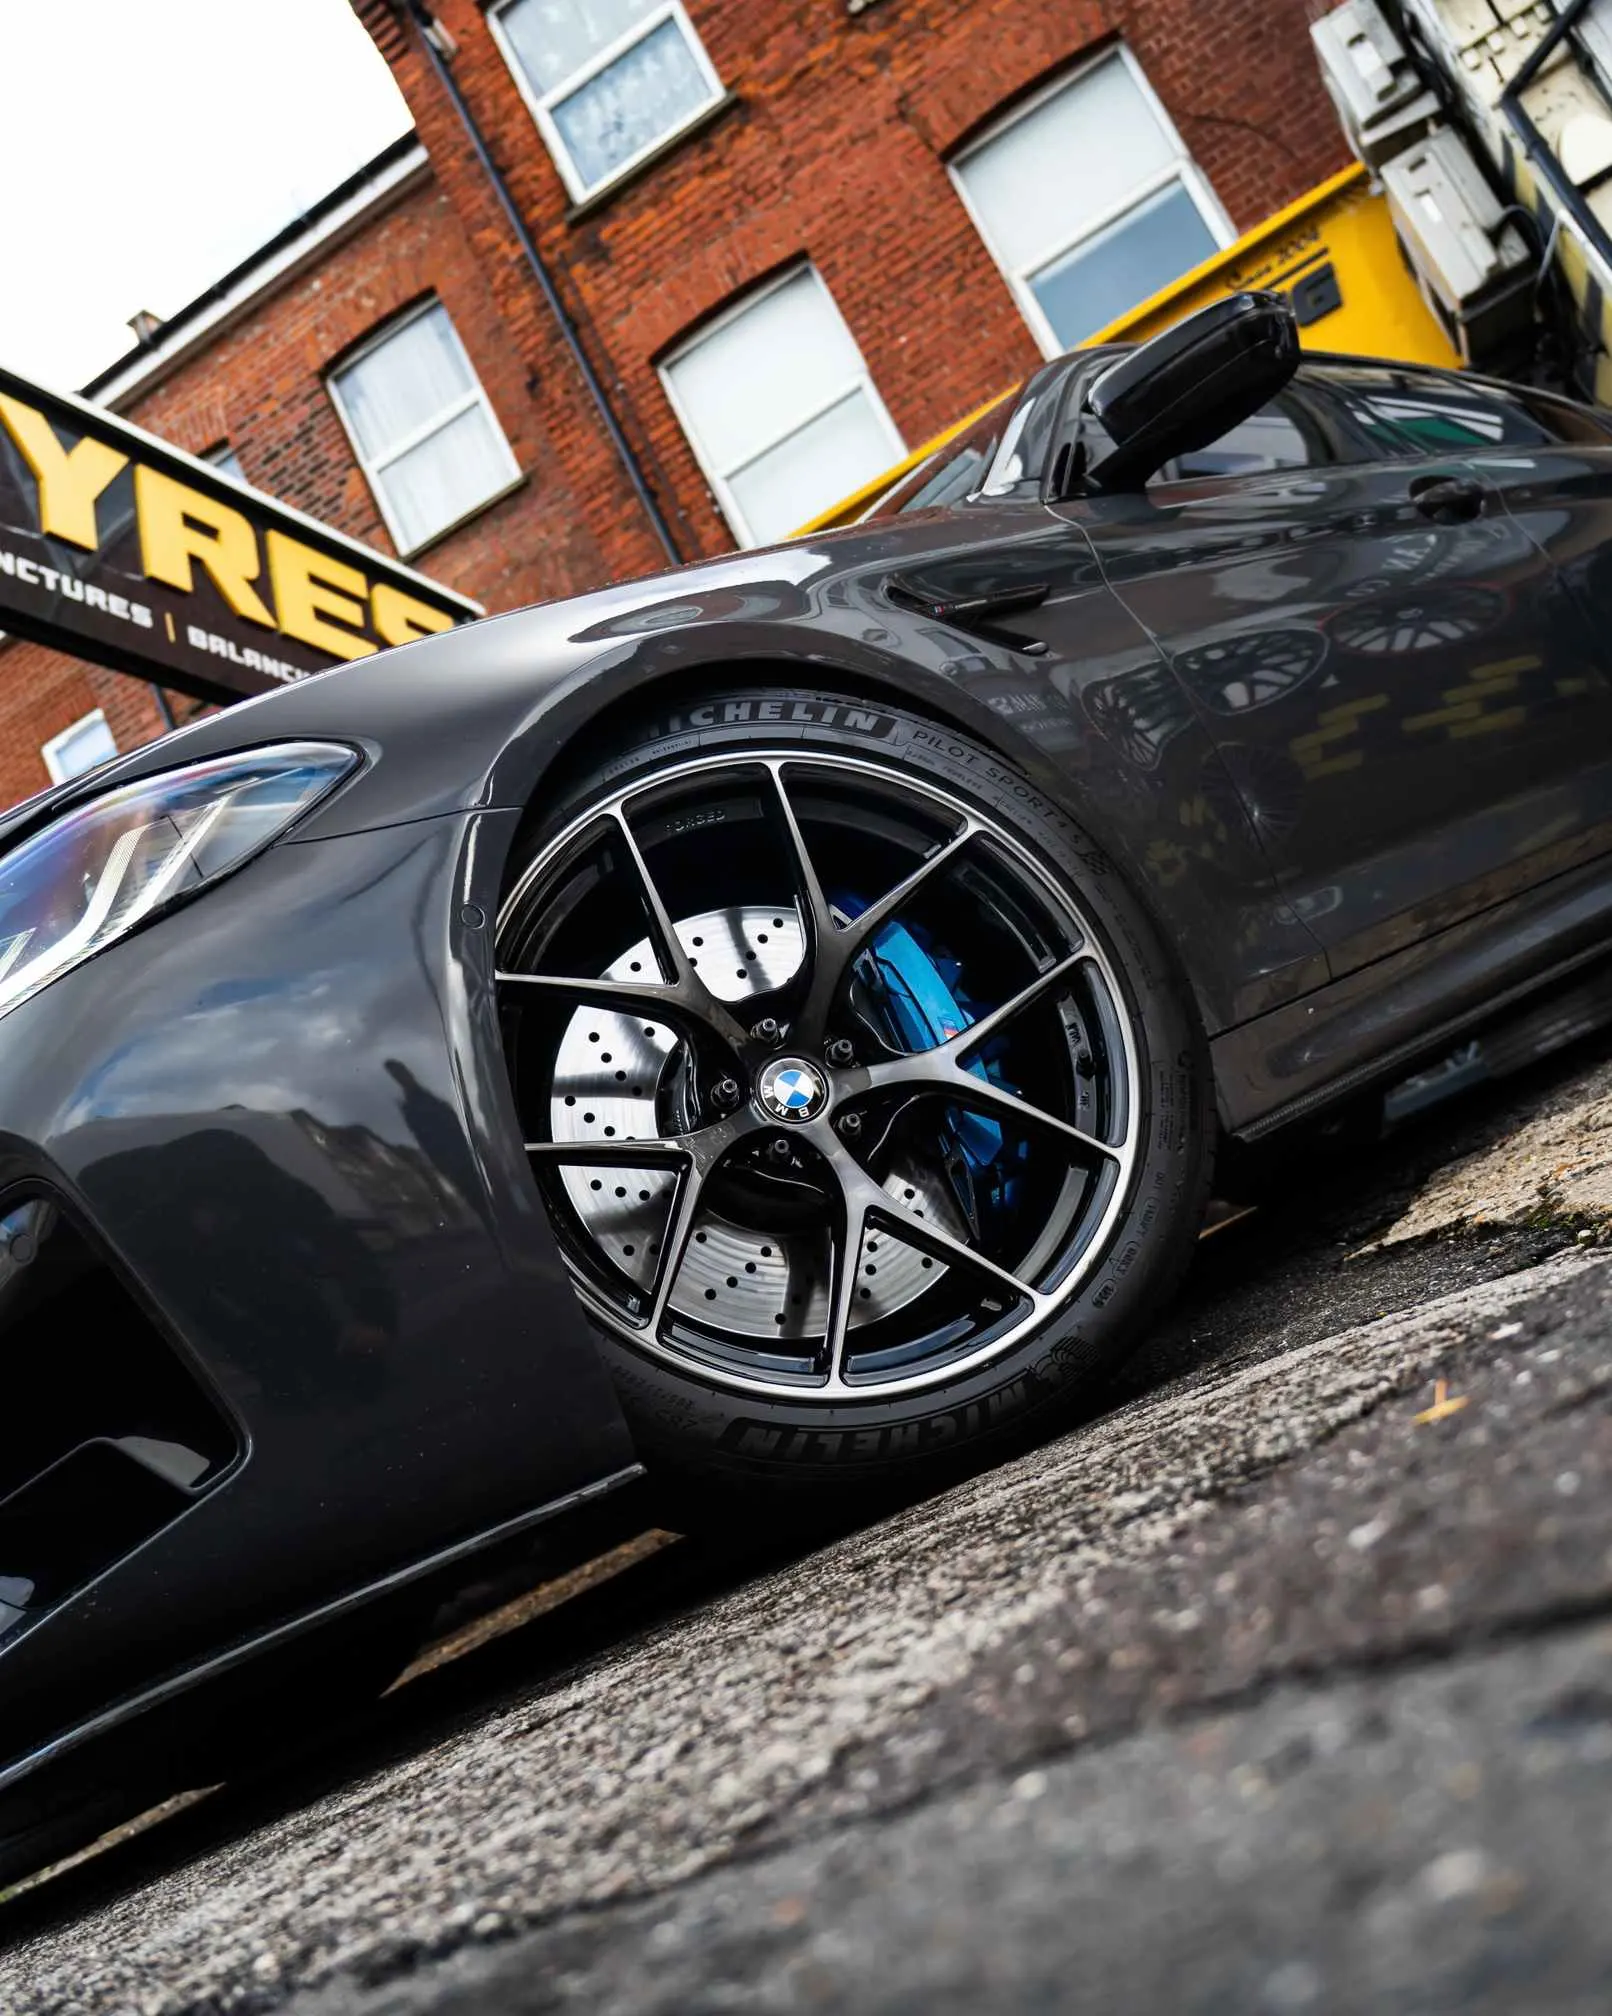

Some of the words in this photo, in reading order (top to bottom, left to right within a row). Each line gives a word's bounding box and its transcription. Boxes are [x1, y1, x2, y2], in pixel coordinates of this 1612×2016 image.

[0, 551, 153, 629] NCTURES
[187, 625, 311, 683] BALANCI
[643, 701, 880, 737] ICHELIN
[912, 729, 980, 765] PILOT
[985, 767, 1059, 818] SPORT
[763, 1084, 810, 1118] BMW
